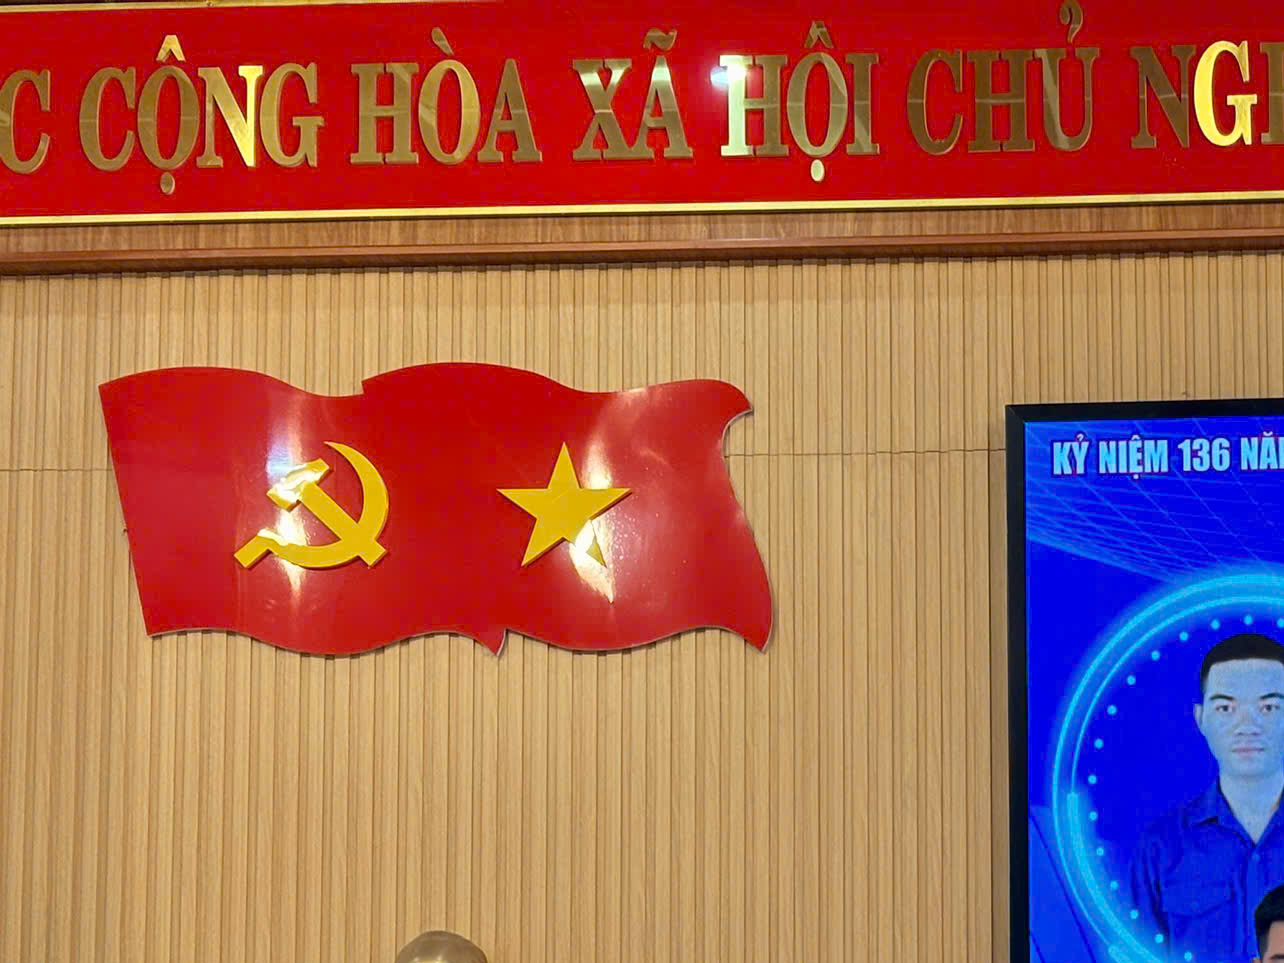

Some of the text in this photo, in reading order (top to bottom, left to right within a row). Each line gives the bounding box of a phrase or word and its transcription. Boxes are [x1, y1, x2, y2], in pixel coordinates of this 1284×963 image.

[79, 35, 324, 195] CỘNG
[350, 27, 543, 166] HÒA
[573, 28, 693, 160] XÃ
[720, 21, 880, 182] HỘI
[907, 0, 1099, 155] CHỦ
[1053, 433, 1089, 475] KỶ
[1099, 434, 1168, 479] NIỆM
[1178, 438, 1231, 472] 136
